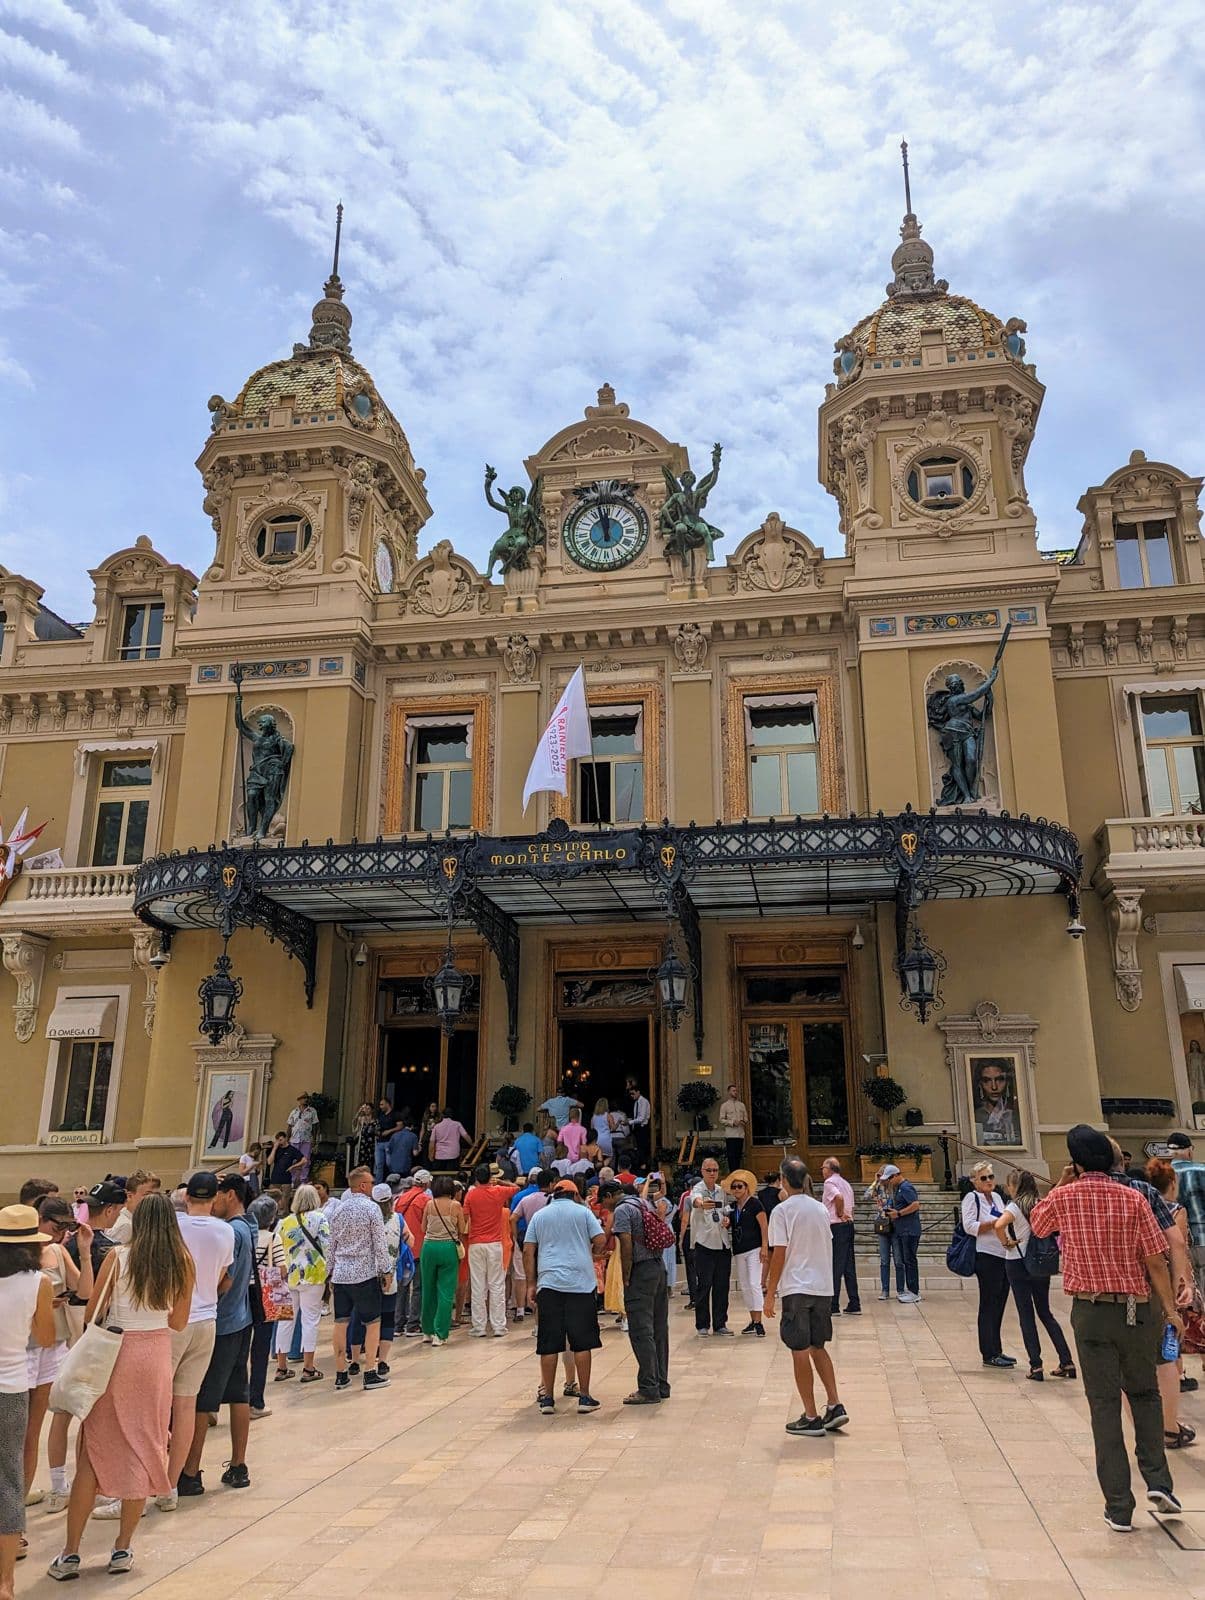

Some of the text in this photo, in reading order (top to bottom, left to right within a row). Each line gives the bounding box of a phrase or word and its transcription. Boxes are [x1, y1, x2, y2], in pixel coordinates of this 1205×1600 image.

[557, 718, 567, 760] RAINIER
[528, 842, 590, 853] CASINO
[490, 849, 626, 865] MONTE-CARLO
